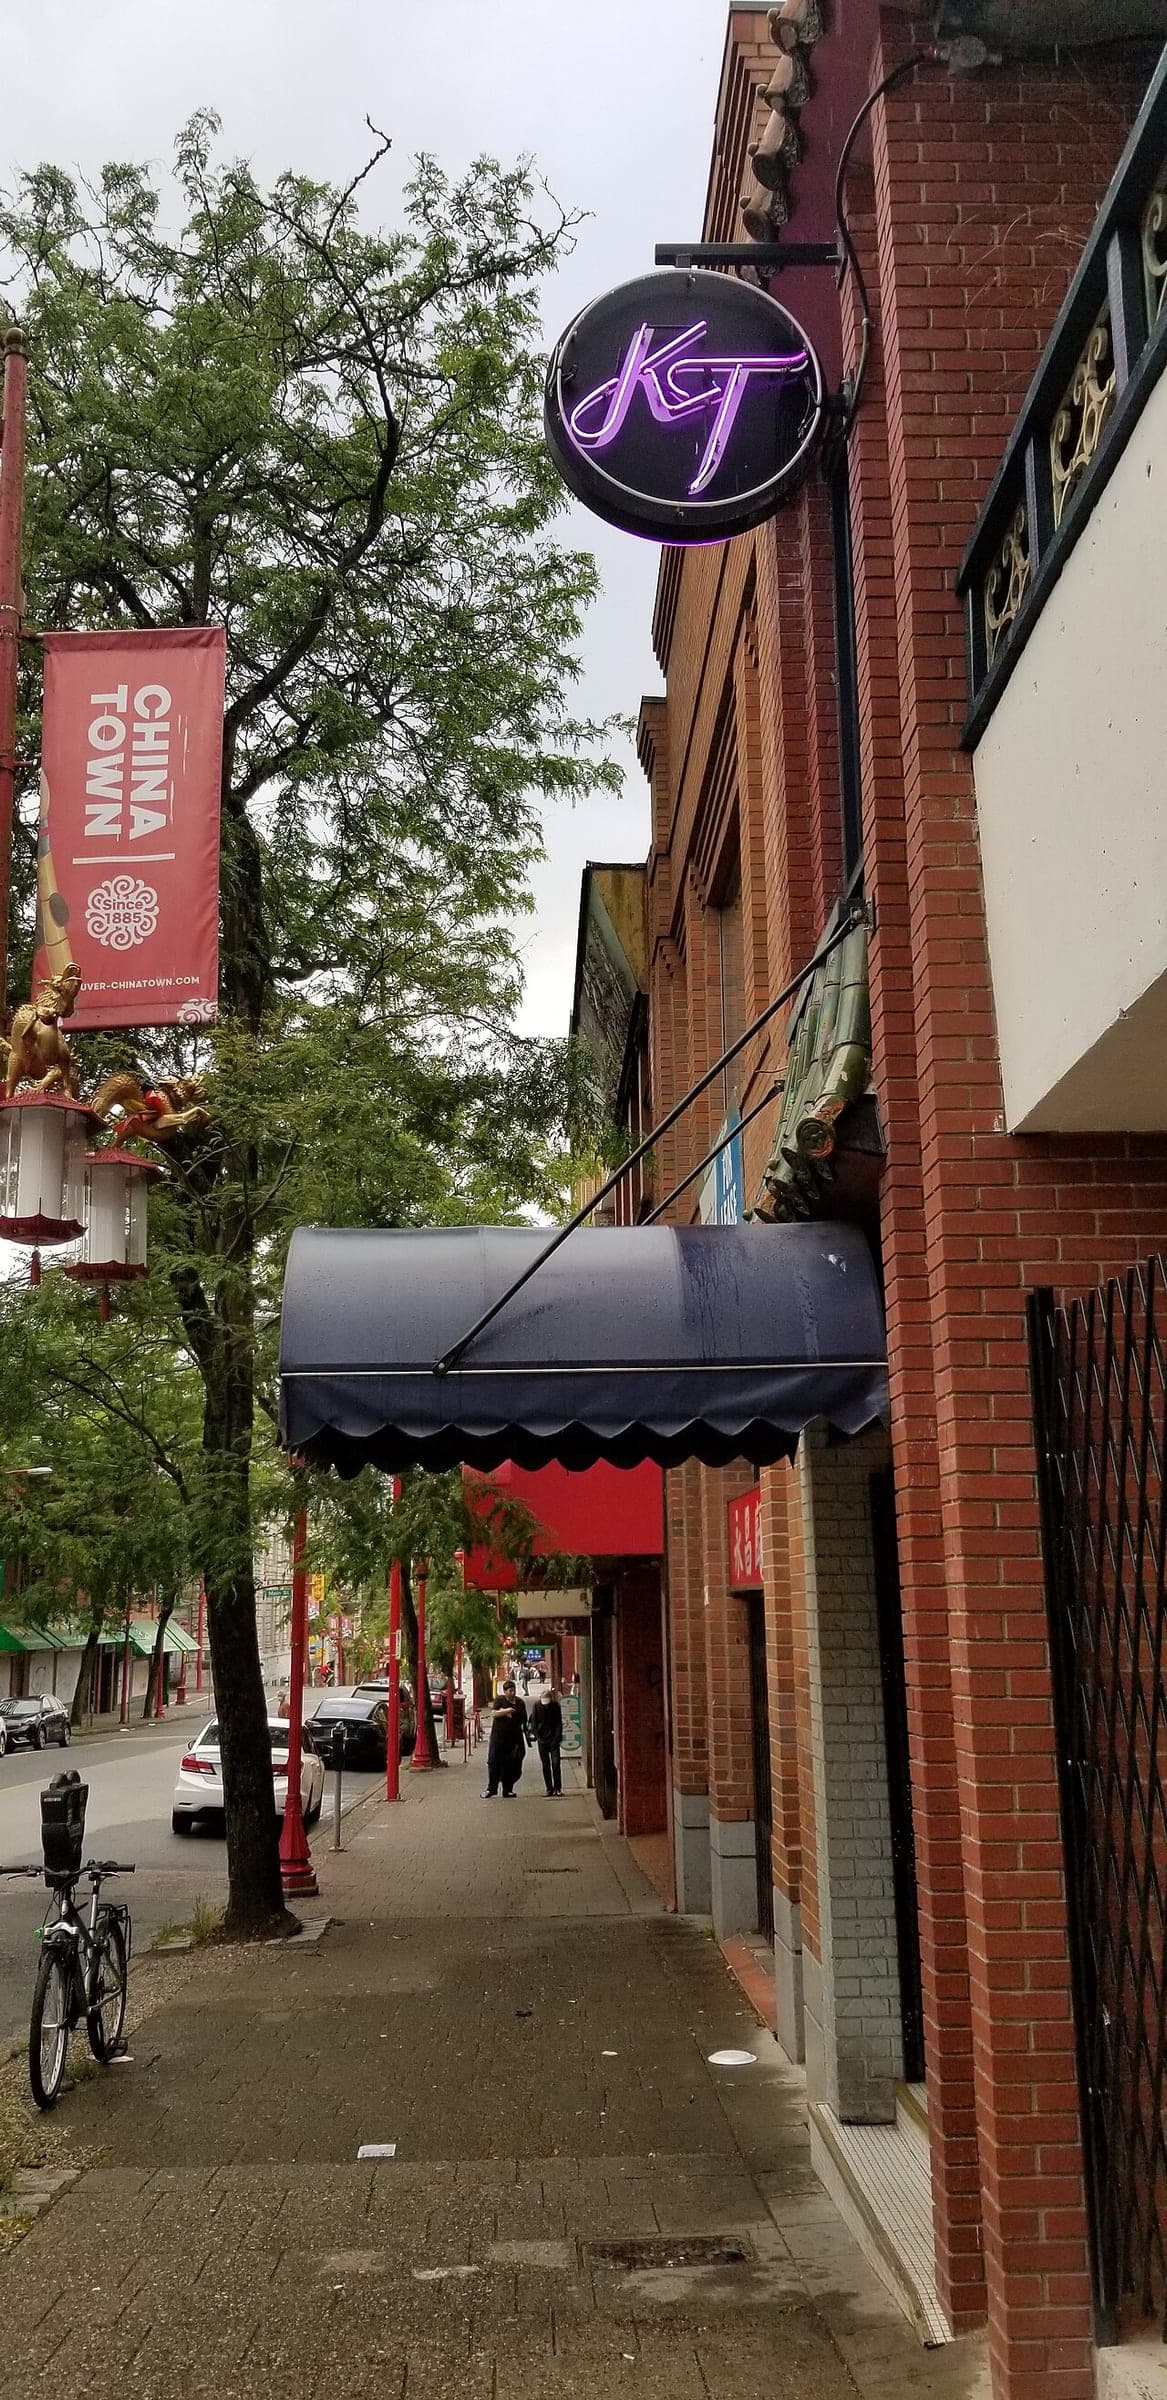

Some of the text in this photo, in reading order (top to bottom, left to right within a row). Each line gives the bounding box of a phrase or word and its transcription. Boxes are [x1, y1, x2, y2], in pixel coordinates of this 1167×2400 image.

[571, 320, 808, 495] KT
[84, 684, 129, 837] TOWN
[129, 684, 172, 841] CHINA
[102, 899, 144, 911] Since
[104, 912, 142, 924] 1885
